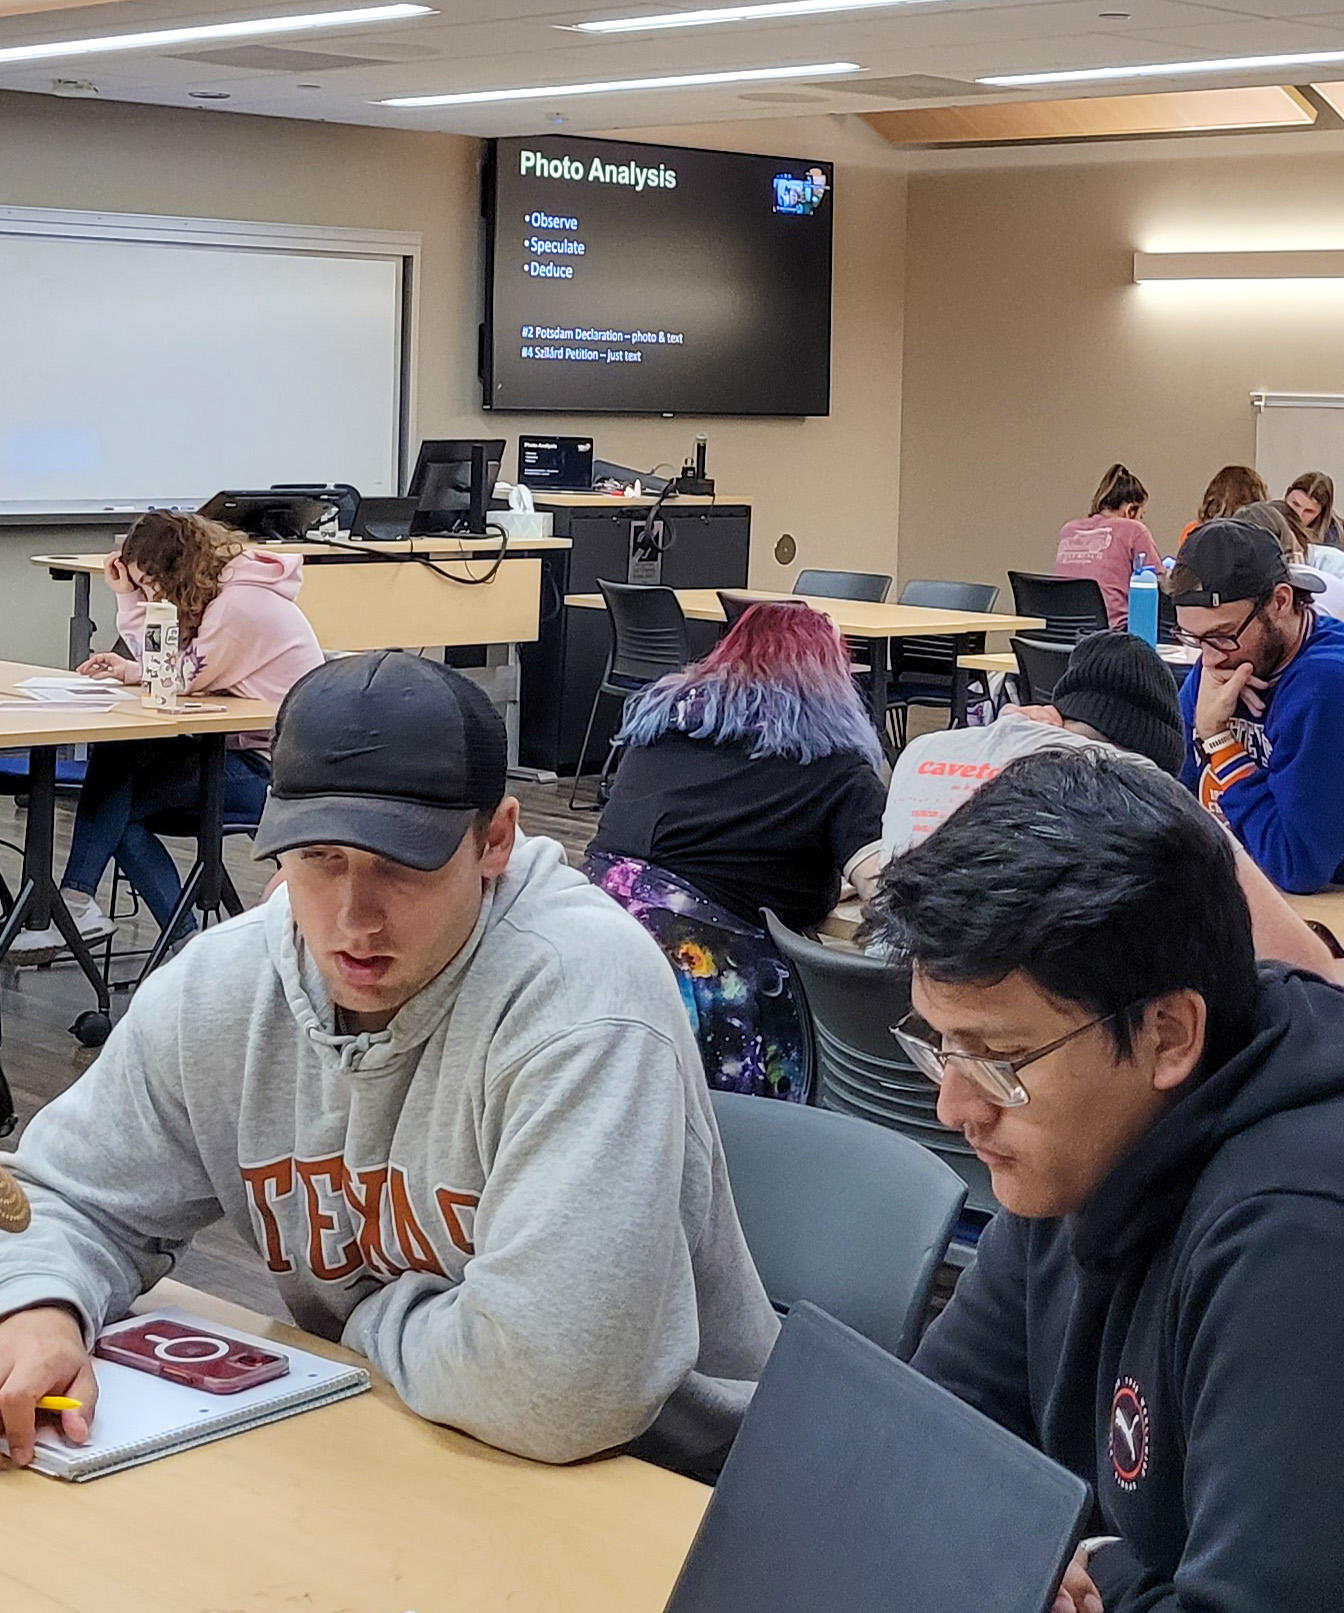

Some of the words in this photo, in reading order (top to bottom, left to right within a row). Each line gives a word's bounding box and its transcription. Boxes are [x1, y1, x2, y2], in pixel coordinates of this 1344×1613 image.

[520, 150, 584, 180] Photo
[587, 157, 677, 191] Analysis
[531, 212, 578, 230] Observe
[530, 236, 585, 255] Speculate
[530, 261, 574, 278] Deduce
[521, 326, 534, 338] #2
[535, 326, 574, 339] Potsdam
[575, 328, 623, 341] Declaration
[631, 330, 657, 345] photo
[658, 331, 666, 343] &
[666, 332, 683, 344] text
[521, 346, 533, 358] #4
[565, 347, 599, 360] Petition
[606, 348, 624, 363] just
[624, 350, 642, 362] text
